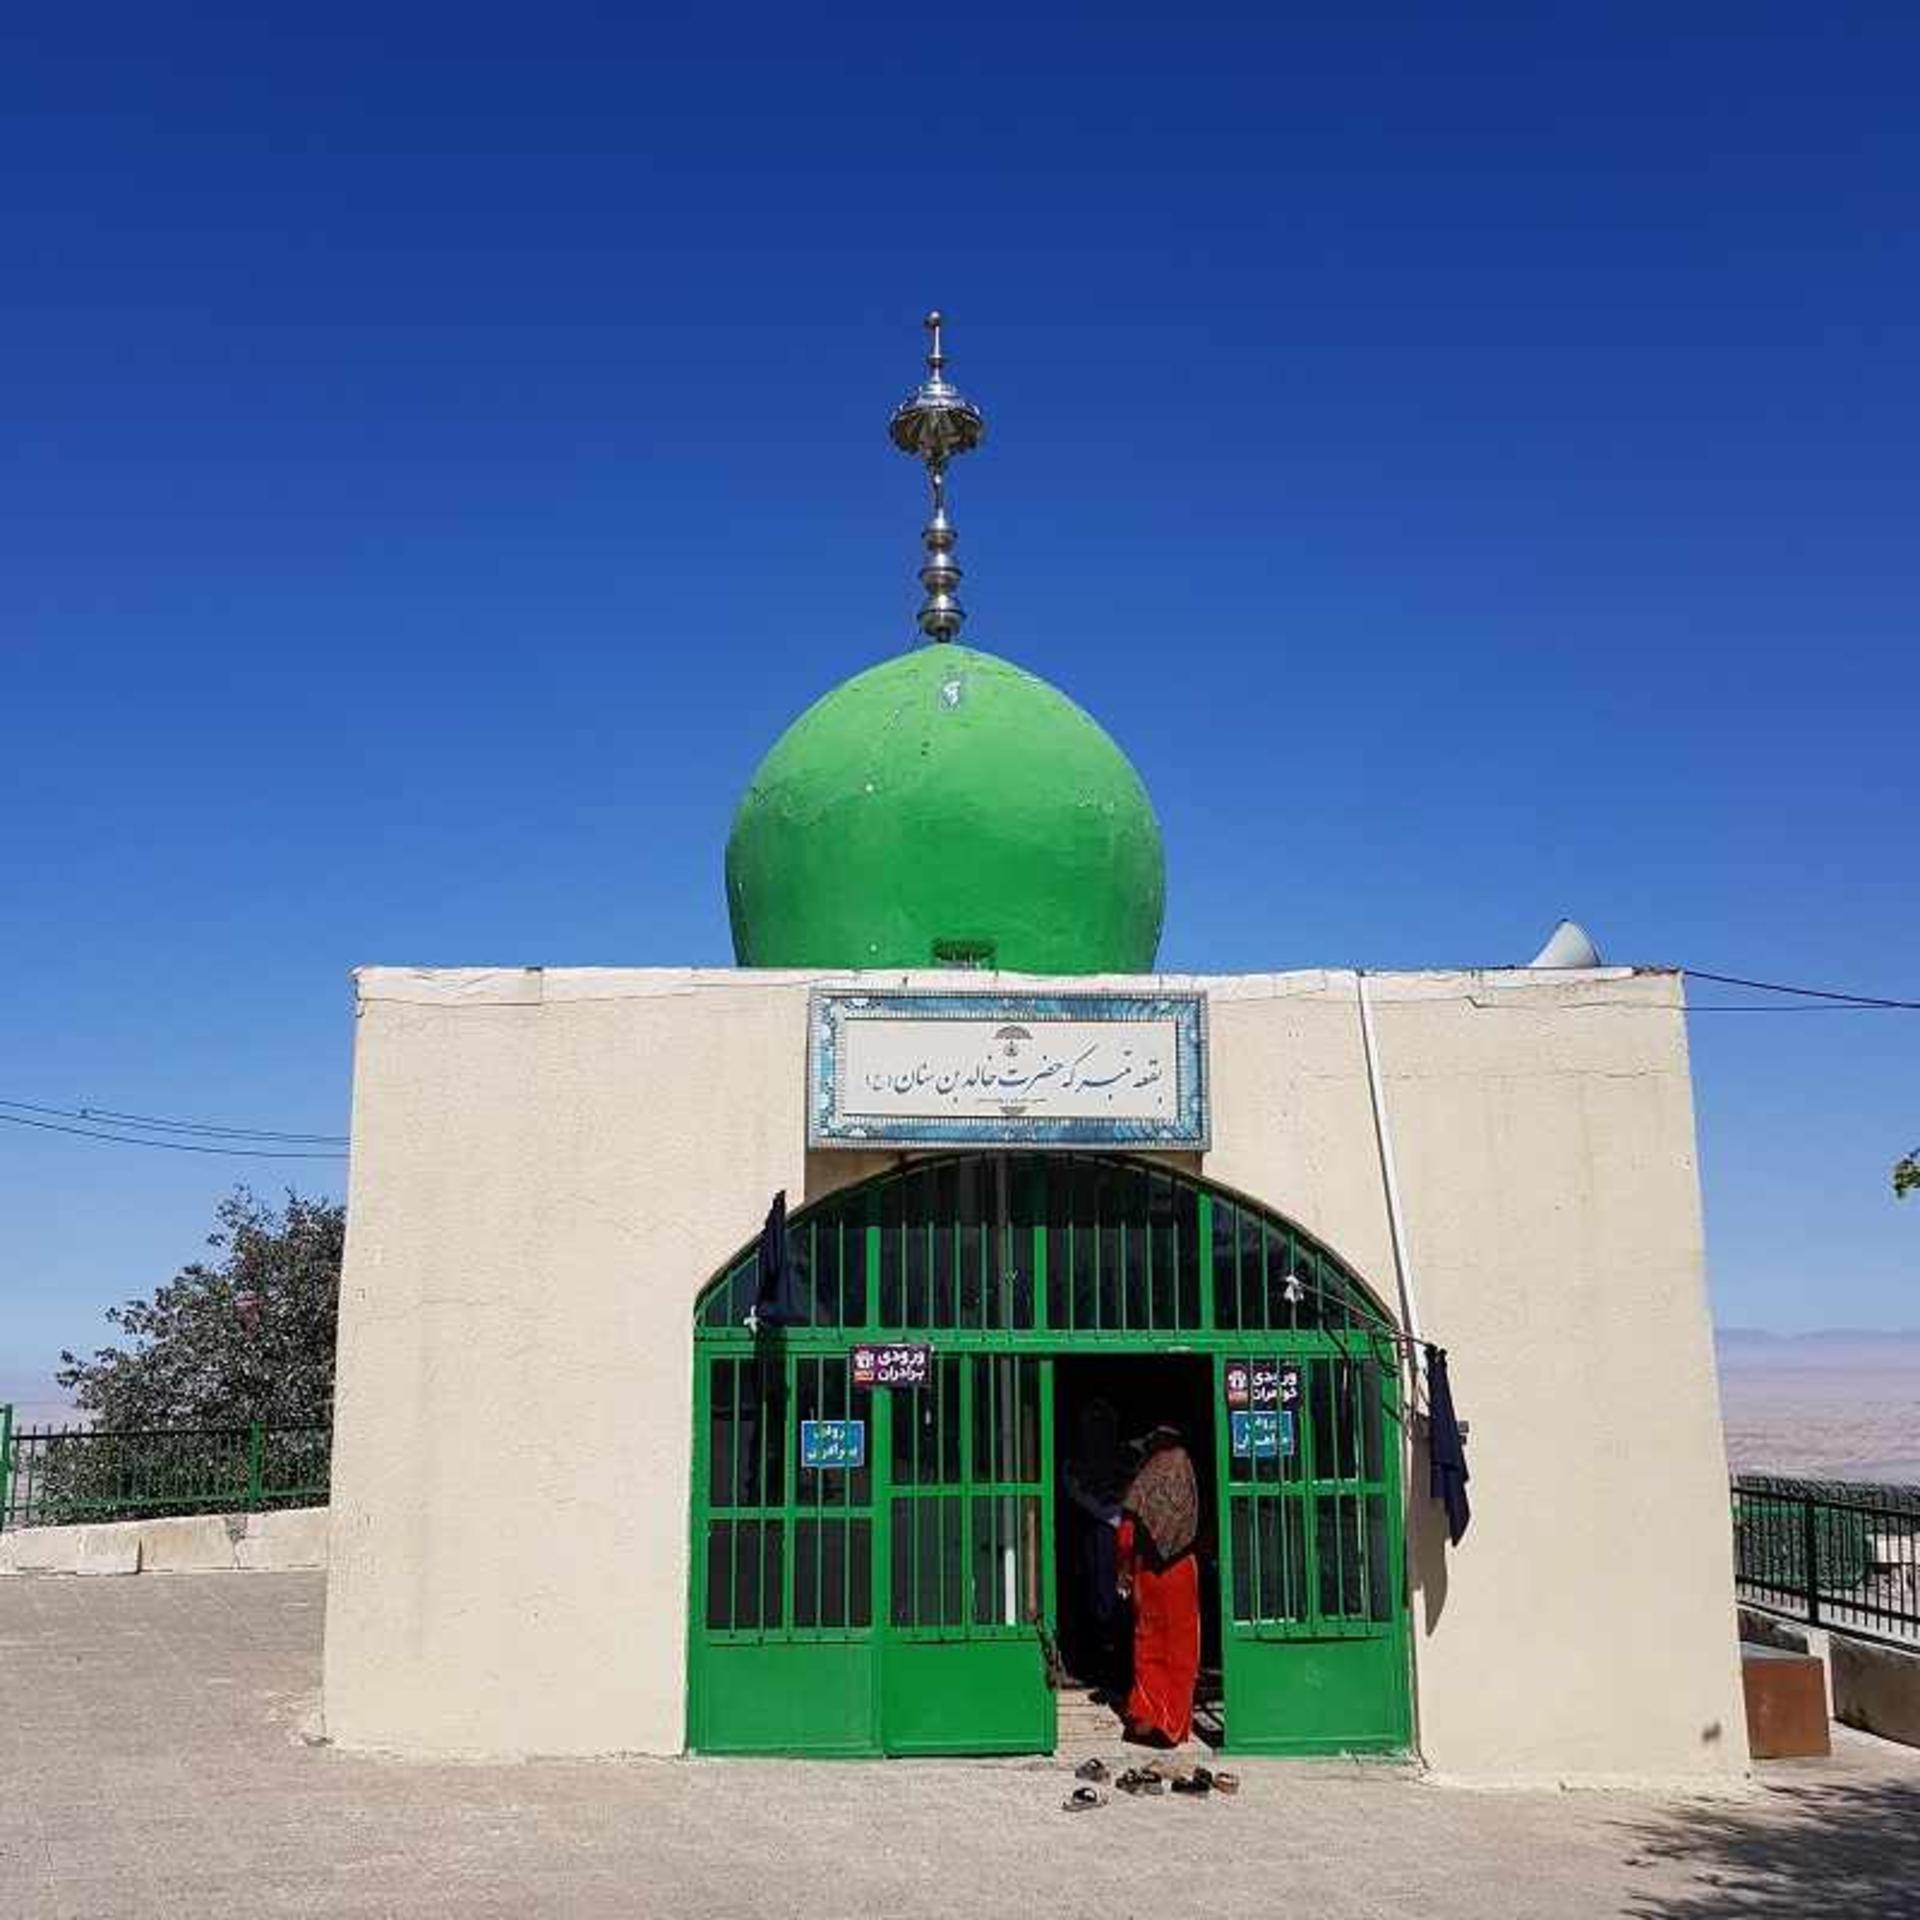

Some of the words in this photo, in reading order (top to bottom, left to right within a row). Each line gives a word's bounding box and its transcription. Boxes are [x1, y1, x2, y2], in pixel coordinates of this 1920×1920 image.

[894, 1062, 935, 1095] سنان
[935, 1069, 961, 1104] بن
[962, 1055, 998, 1089] خالد
[997, 1055, 1064, 1093] حضرت
[1132, 1060, 1163, 1105] بقعه
[877, 1350, 925, 1366] ورودی
[877, 1365, 925, 1382] برادران
